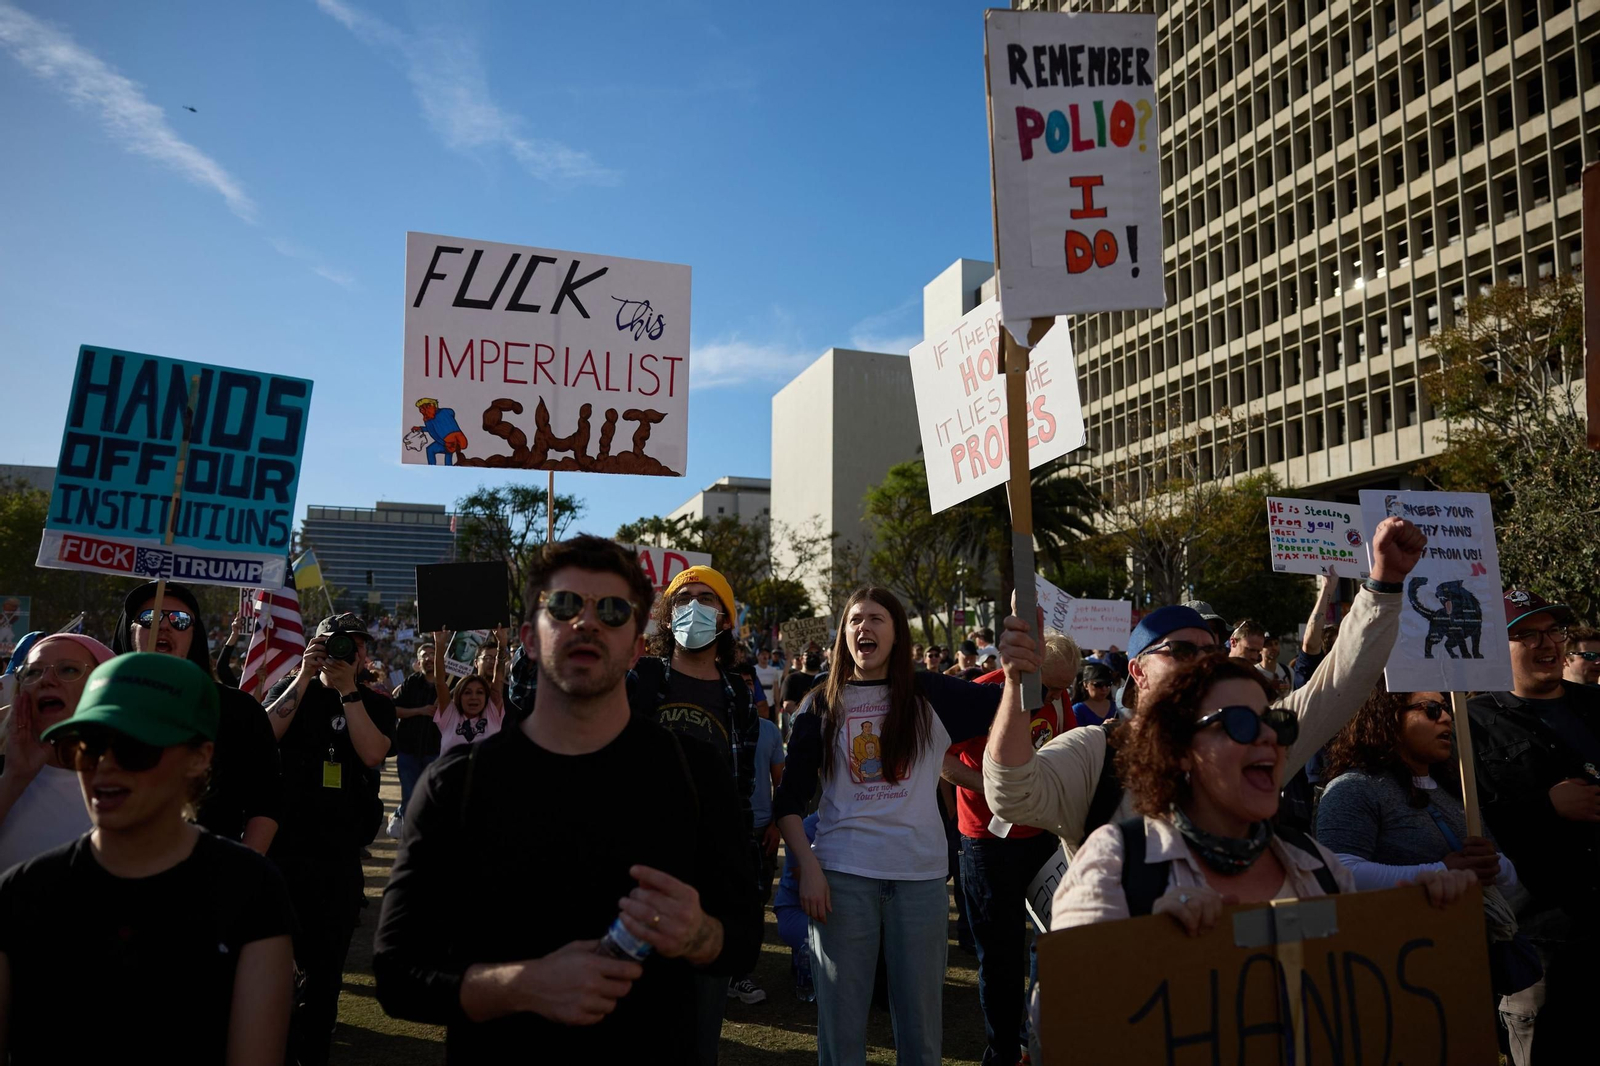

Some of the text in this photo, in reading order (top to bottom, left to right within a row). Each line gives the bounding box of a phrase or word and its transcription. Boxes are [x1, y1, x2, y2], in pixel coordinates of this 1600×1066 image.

[1007, 43, 1153, 89] REMEMBER
[1015, 99, 1153, 161] POLIO?
[1069, 175, 1107, 219] I
[1065, 225, 1140, 278] DO!
[413, 245, 609, 319] FUCK
[424, 335, 683, 397] IMPERIALIST
[933, 340, 949, 370] IF
[69, 350, 306, 457] HANDS
[935, 417, 952, 447] IT
[956, 388, 1001, 436] LIES
[1027, 360, 1052, 395] HE
[482, 395, 668, 461] SHIT
[59, 431, 296, 504] OFF OUR
[1269, 500, 1284, 514] HE
[1289, 505, 1300, 514] is
[1410, 504, 1474, 518] KEEP YOUR
[63, 539, 263, 581] FUCK TRUMP
[1276, 553, 1300, 561] TAX
[1429, 547, 1461, 560] FROM
[1463, 548, 1482, 560] US!
[445, 665, 470, 675] EMOCRACY
[660, 708, 712, 734] NASA
[854, 788, 909, 801] Your Friends
[1128, 938, 1449, 1066] HANDS
